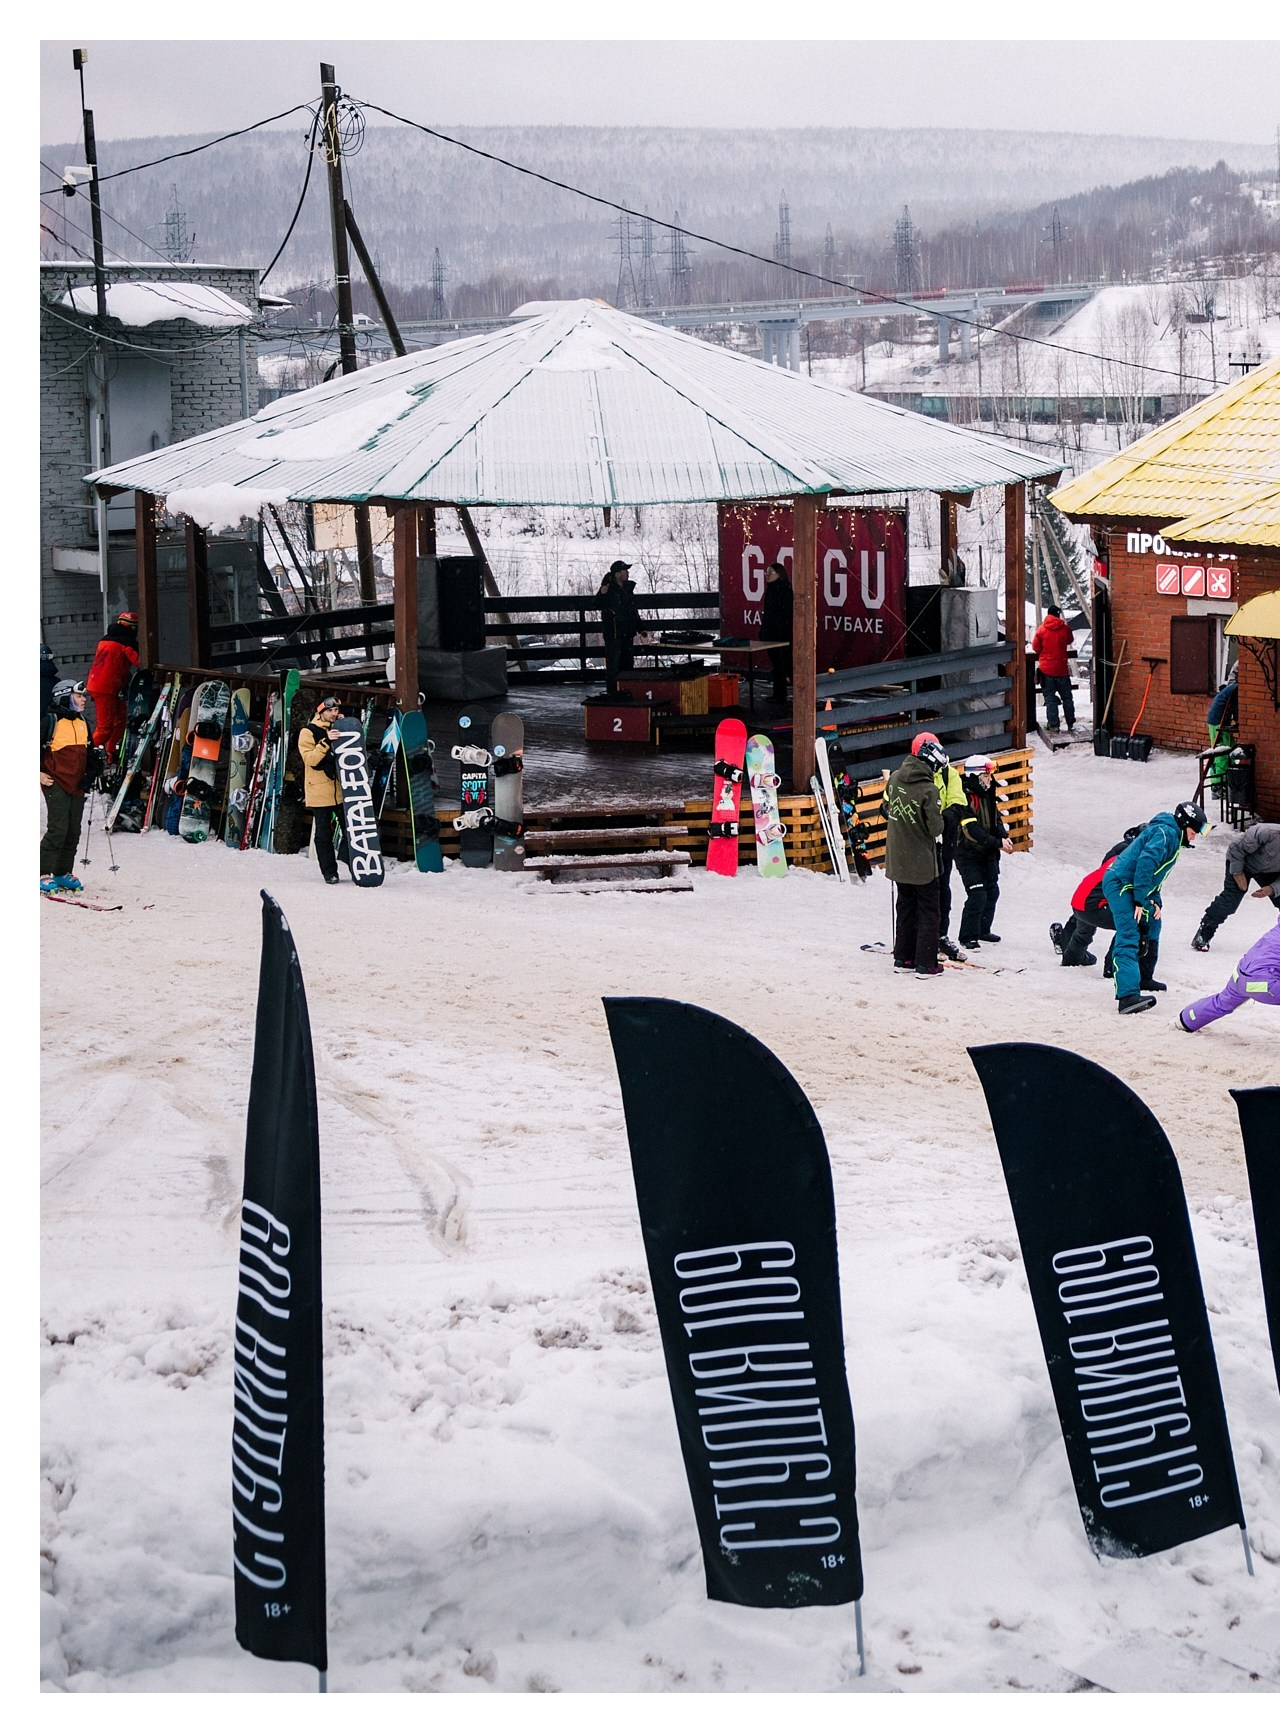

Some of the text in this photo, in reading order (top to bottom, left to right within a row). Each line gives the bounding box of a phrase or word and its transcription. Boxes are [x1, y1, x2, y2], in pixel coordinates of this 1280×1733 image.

[824, 615, 884, 634] ГУБАХЕ
[645, 690, 653, 700] 1
[613, 717, 623, 732] 2
[462, 780, 487, 791] SCOTT
[334, 731, 384, 881] BATALEON
[238, 1198, 291, 1320] 109
[1052, 1234, 1204, 1509] СТУДИЯ 109
[673, 1240, 841, 1551] СТУДИЯ 109
[1187, 1494, 1210, 1509] 18+
[820, 1553, 846, 1570] 18+
[263, 1601, 292, 1618] 18+
